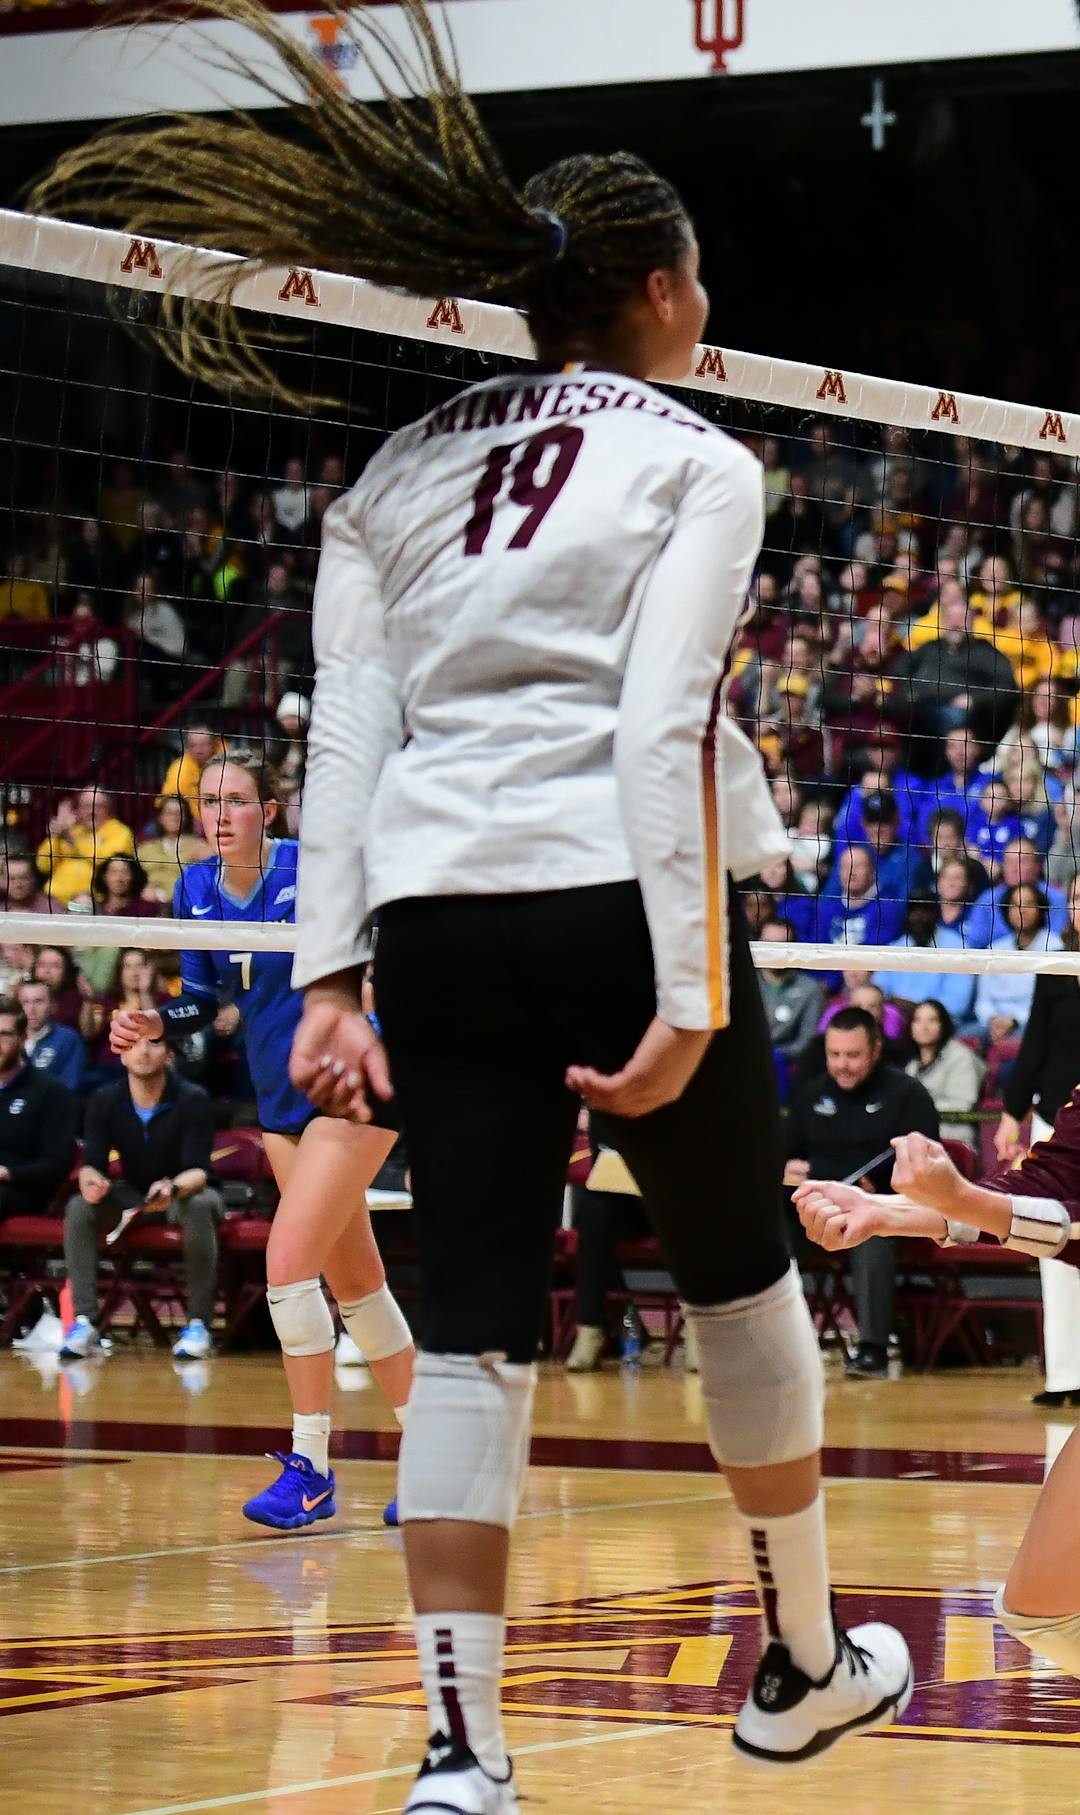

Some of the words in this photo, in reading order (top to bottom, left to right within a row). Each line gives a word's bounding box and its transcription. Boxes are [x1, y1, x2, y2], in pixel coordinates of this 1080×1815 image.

[121, 239, 163, 279] M
[278, 267, 319, 306] M
[427, 297, 465, 334] M
[695, 347, 727, 381] M
[816, 370, 846, 403] M
[931, 391, 960, 424] M
[1039, 411, 1067, 442] M
[463, 422, 585, 556] 19
[228, 952, 253, 991] 7
